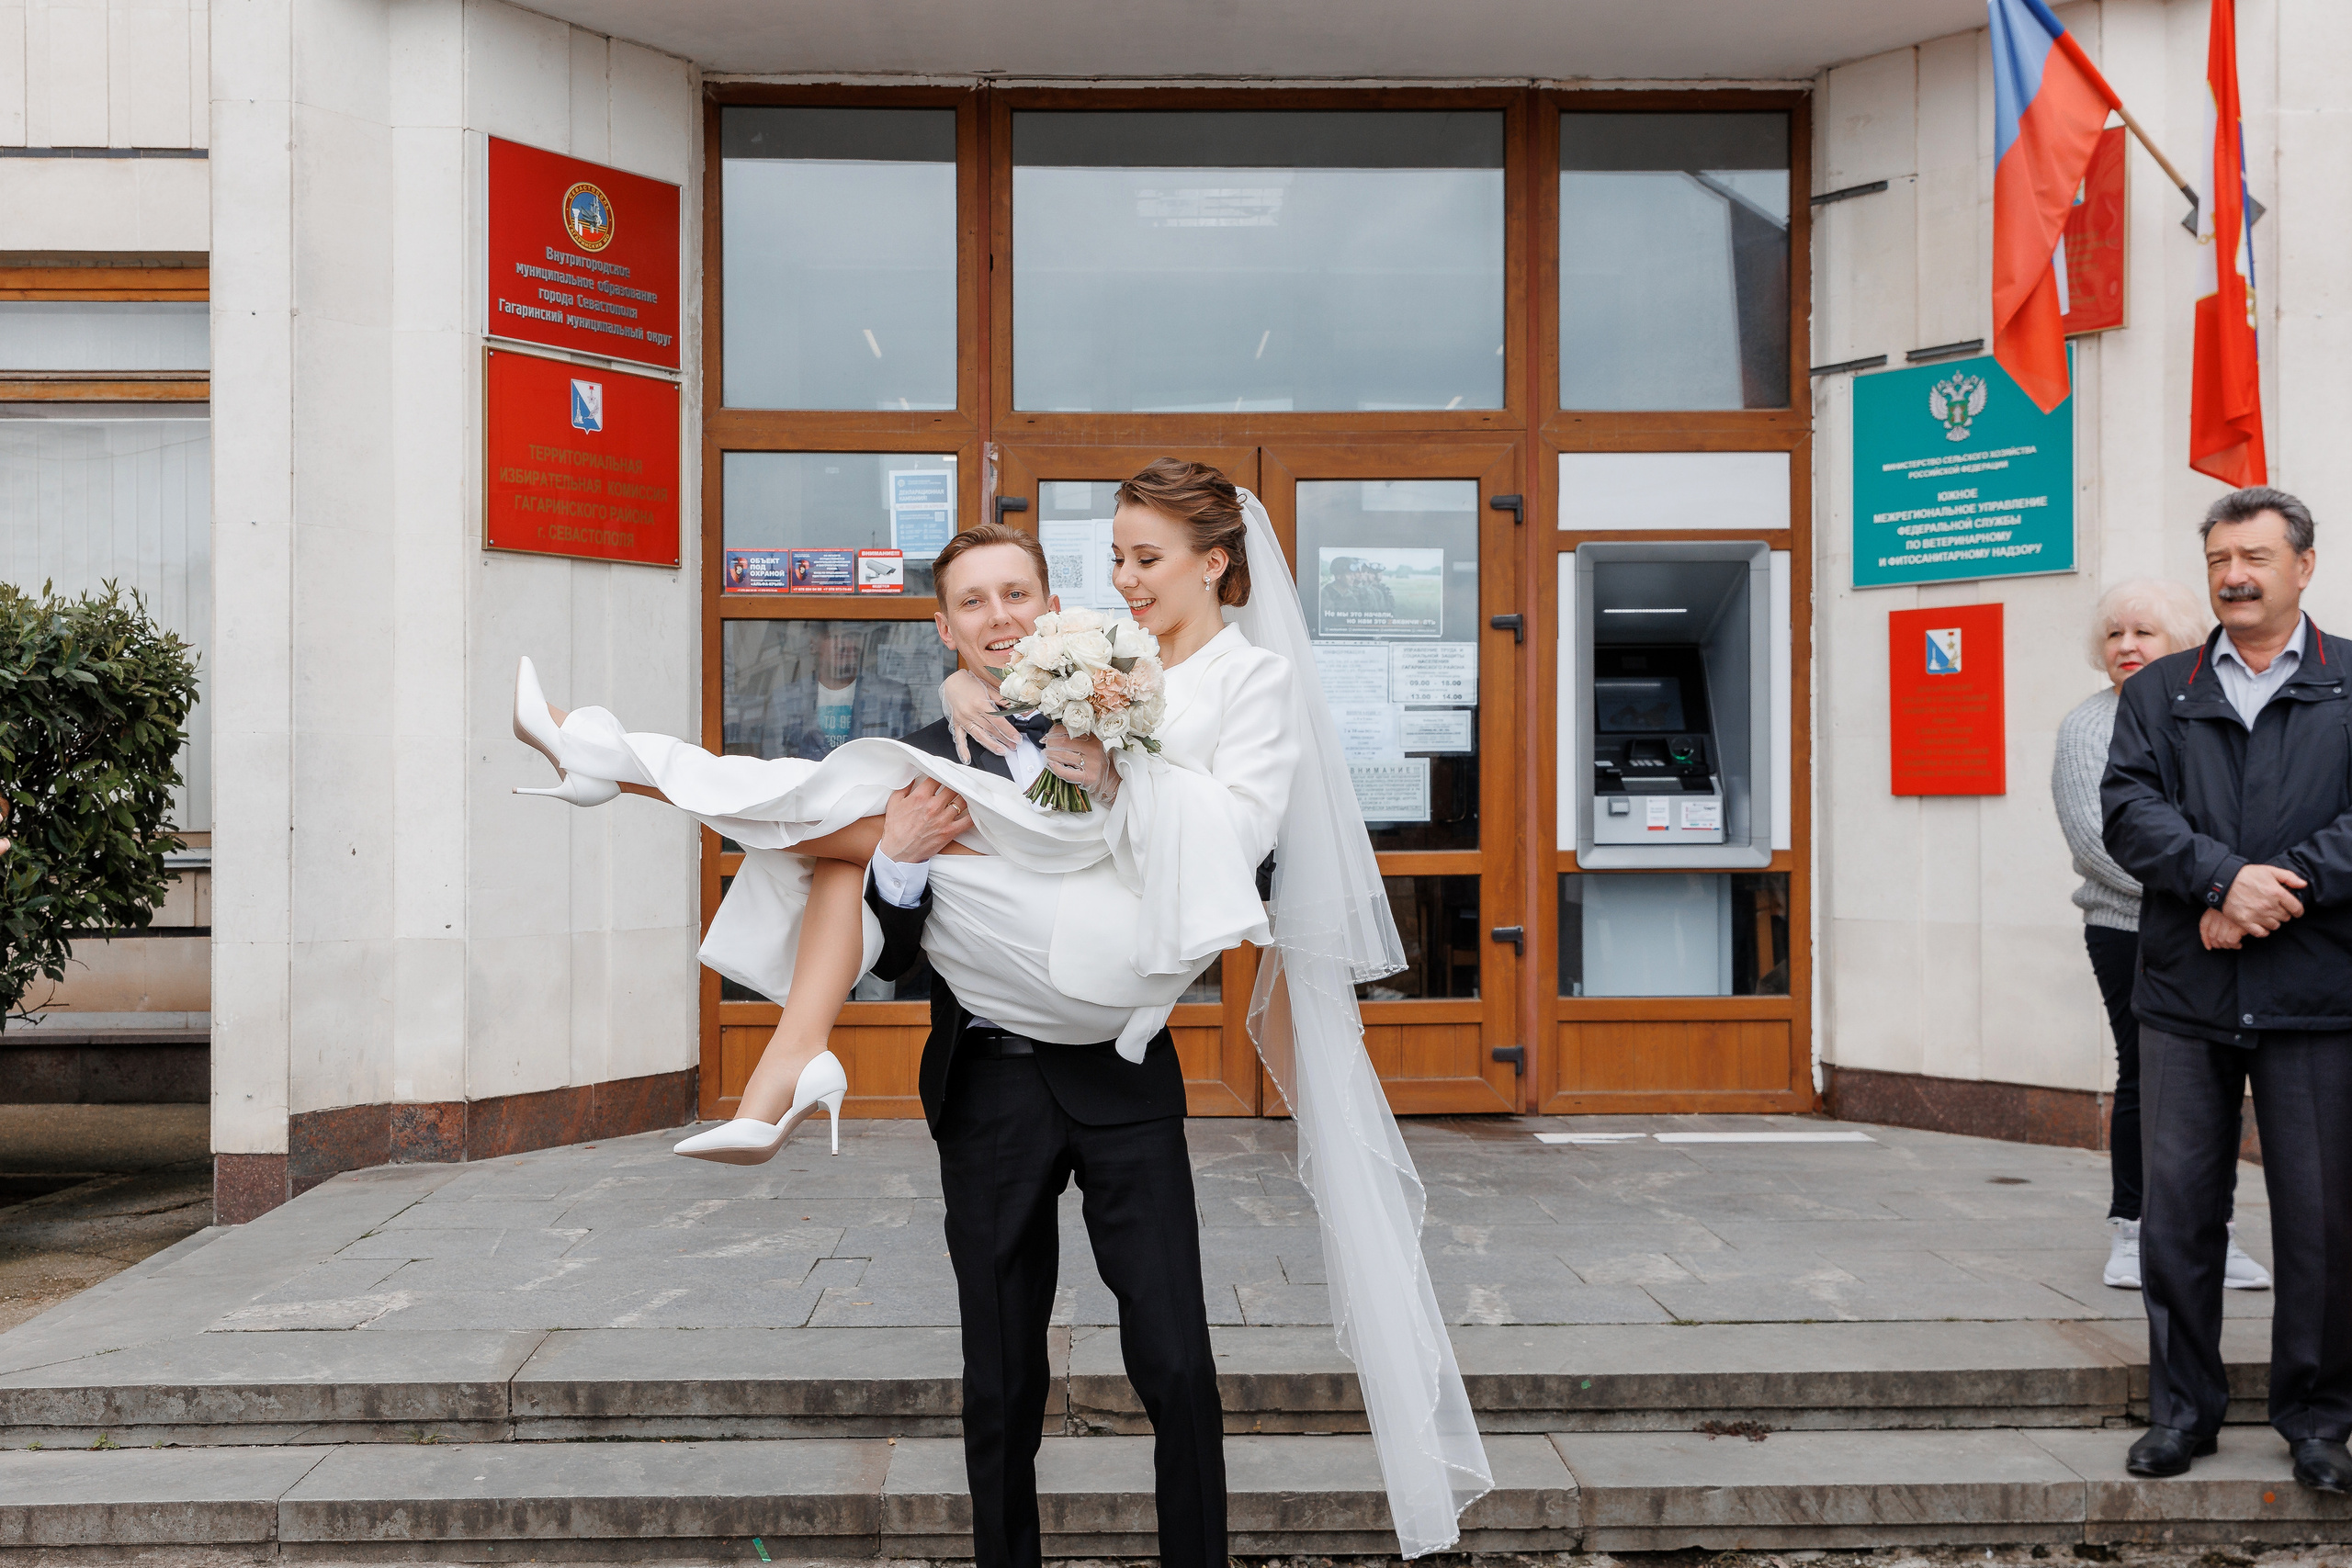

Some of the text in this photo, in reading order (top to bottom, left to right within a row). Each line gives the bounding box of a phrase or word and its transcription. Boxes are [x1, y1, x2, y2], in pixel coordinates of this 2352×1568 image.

[545, 246, 630, 278] Внутригородское
[516, 262, 657, 303] муниципальное образование
[538, 288, 637, 319] города Севастополя
[498, 298, 672, 346] Гагаринский муниципальный округ
[529, 444, 642, 474] ТЕРРИТОРИАЛЬНАЯ
[1882, 446, 2037, 472] МИНИСТЕРСТВО СЕЛЬСКОГО ХОЗЯЙСТВА
[1908, 460, 2009, 479] РОССИЙСКОЙ ФЕДЕРАЦИИ
[499, 467, 668, 502] ИЗБИРАТЕЛЬНАЯ КОМИССИЯ
[1937, 488, 1978, 502] ЮЖНОЕ
[515, 495, 655, 525] ГАГАРИНСКОГО РАЙОНА
[1873, 496, 2048, 524] МЕЖРЕГИОНАЛЬНОЕ УПРАВЛЕНИЕ
[538, 525, 634, 547] г. СЕВАСТОПОЛЯ
[1897, 514, 2022, 537] ФЕДЕРАЛЬНОЙ СЛУЖБЫ
[1906, 531, 2012, 550] ПО ВЕТЕРИНАРНОМУ
[1878, 543, 2042, 567] И ФИТОСАНИТАРНОМУ НАДЗОРУ
[824, 715, 852, 729] TO BE
